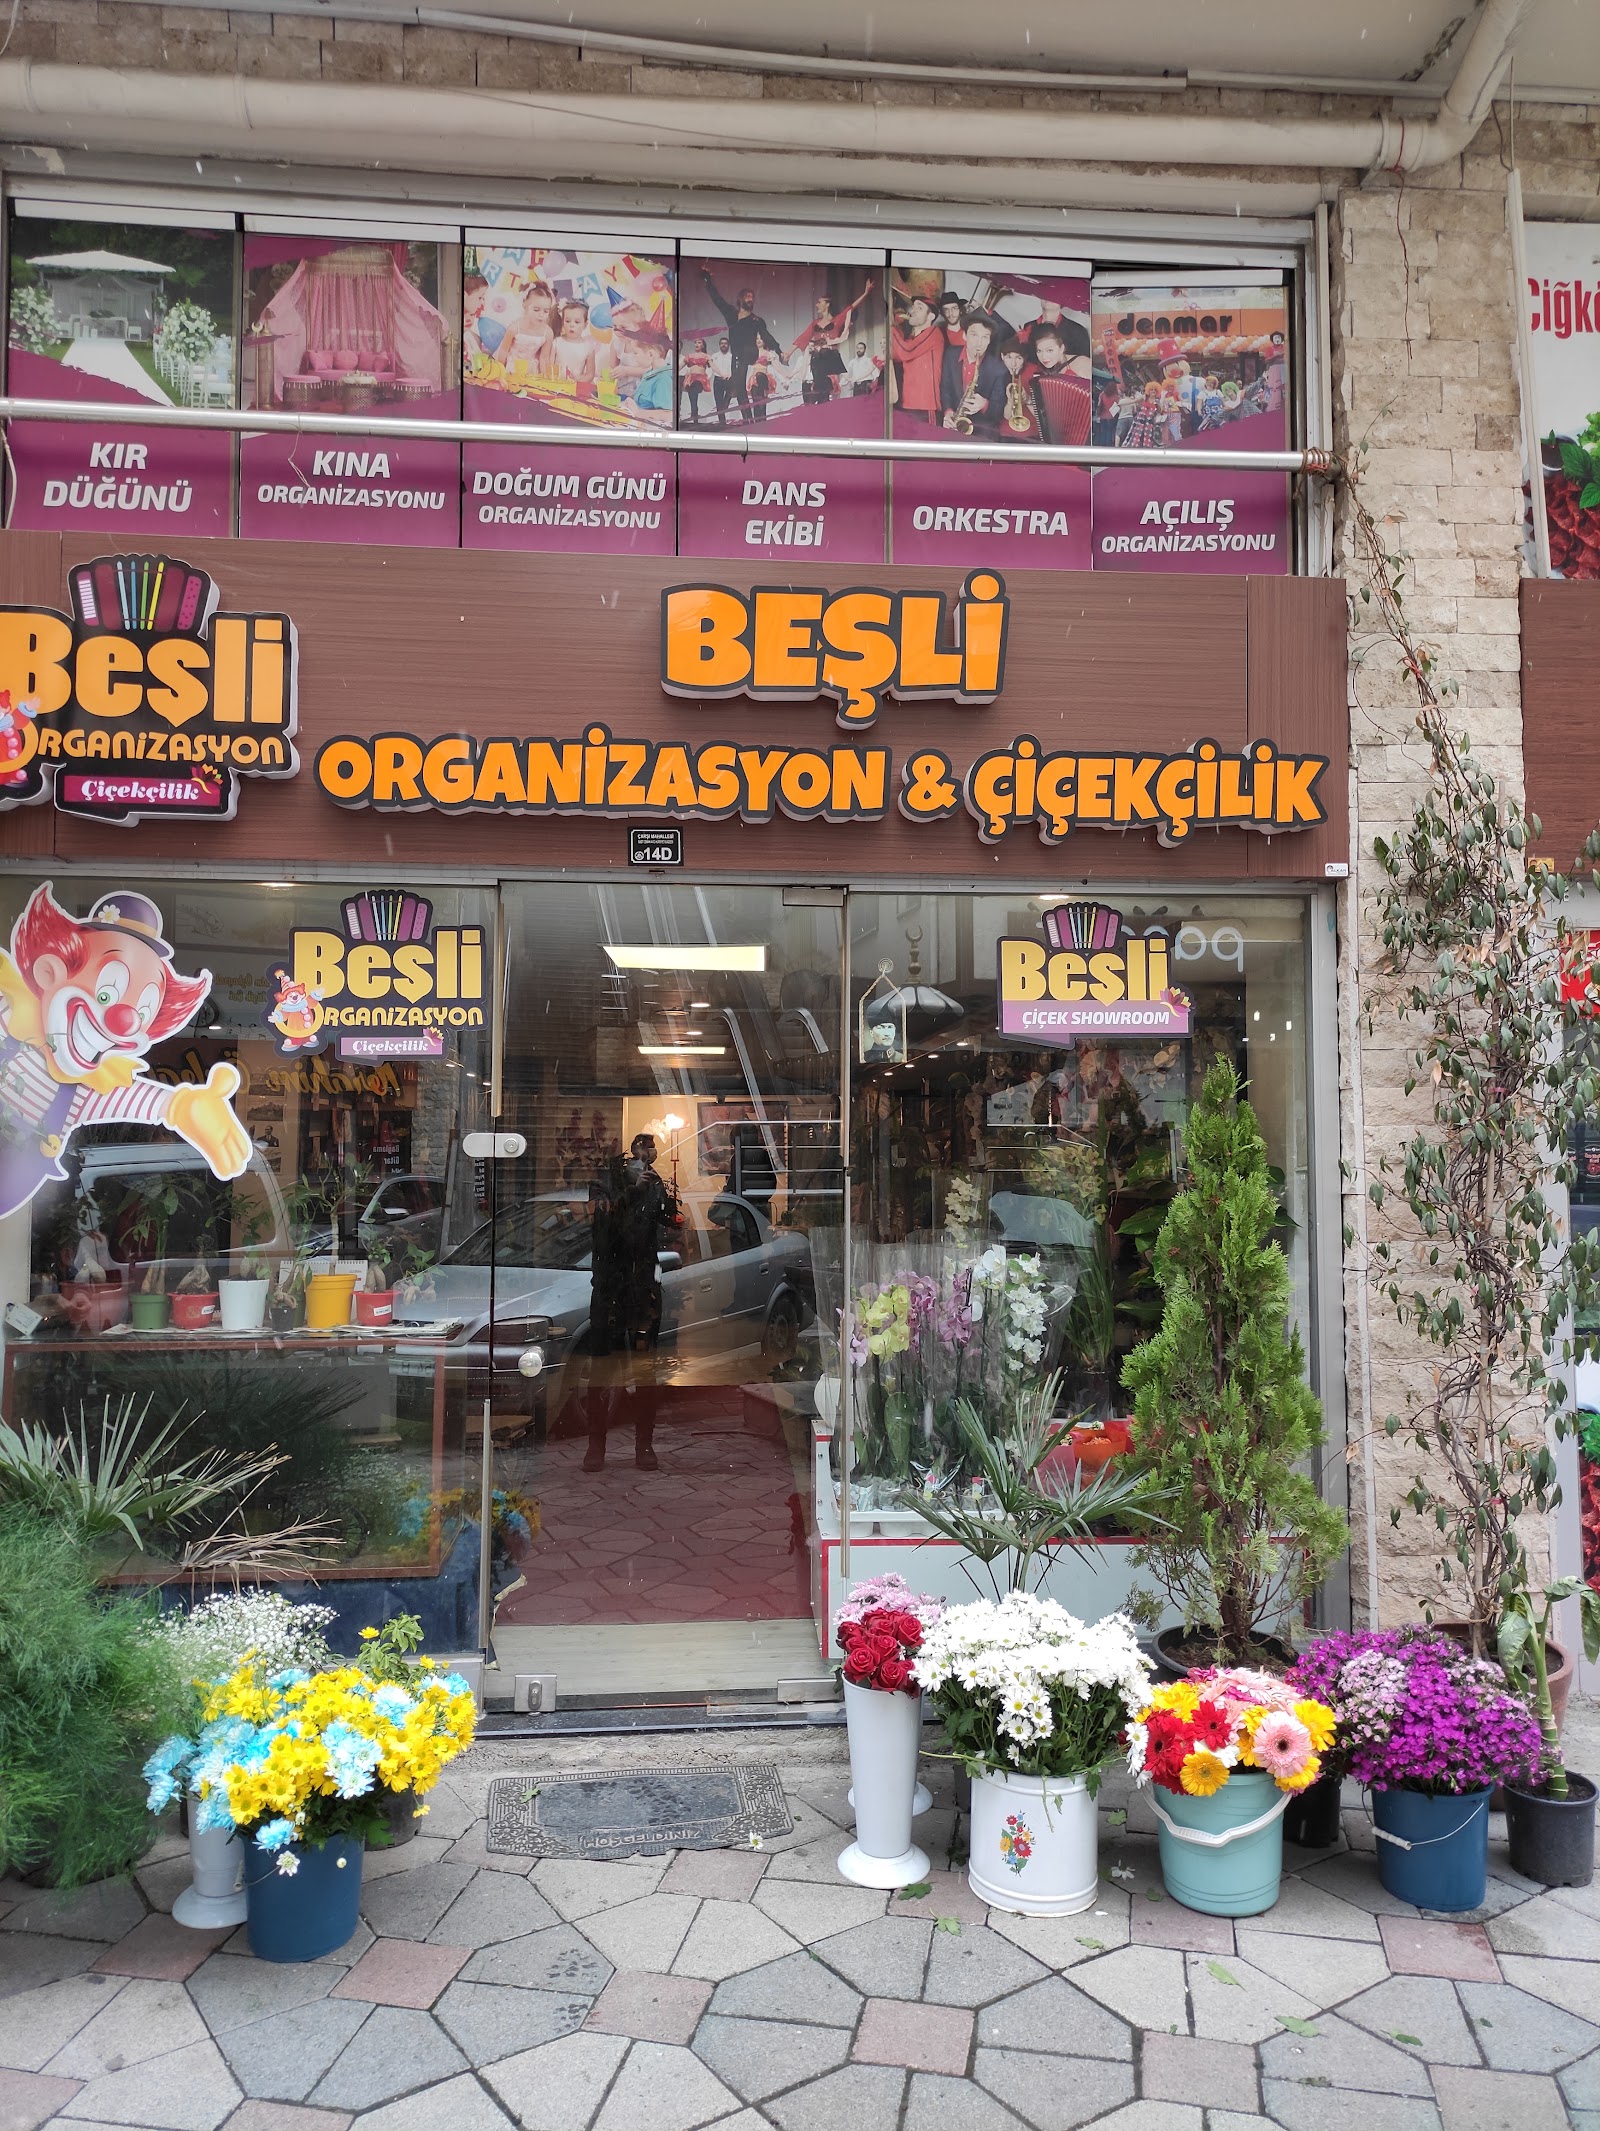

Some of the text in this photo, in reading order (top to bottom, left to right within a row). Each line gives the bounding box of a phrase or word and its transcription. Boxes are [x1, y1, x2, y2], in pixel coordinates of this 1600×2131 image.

[1117, 312, 1233, 336] denmar
[89, 442, 148, 470] KIR
[312, 450, 391, 479] KINA
[43, 478, 193, 513] DÜĞÜNÜ
[257, 483, 446, 510] ORGANİZASYONU
[472, 467, 667, 502] DOĞUM GÜNÜ
[741, 479, 827, 508] DANS
[478, 503, 661, 529] ORGANİZASYONU
[744, 513, 825, 547] EKİBİ
[912, 505, 1069, 536] ORKESTRA
[1139, 499, 1235, 534] AÇILIŞ
[1101, 531, 1276, 554] ORGANİZASYONU
[667, 575, 1004, 718] BEŞLİ
[81, 780, 199, 803] Çiçekçilik
[318, 727, 1323, 838] ORGANİZASYON & ÇİÇEKÇİLİK
[644, 847, 672, 860] 14D
[1022, 1009, 1170, 1029] ÇİÇEK SHOWROOM
[352, 1040, 429, 1055] Çiçekçilik
